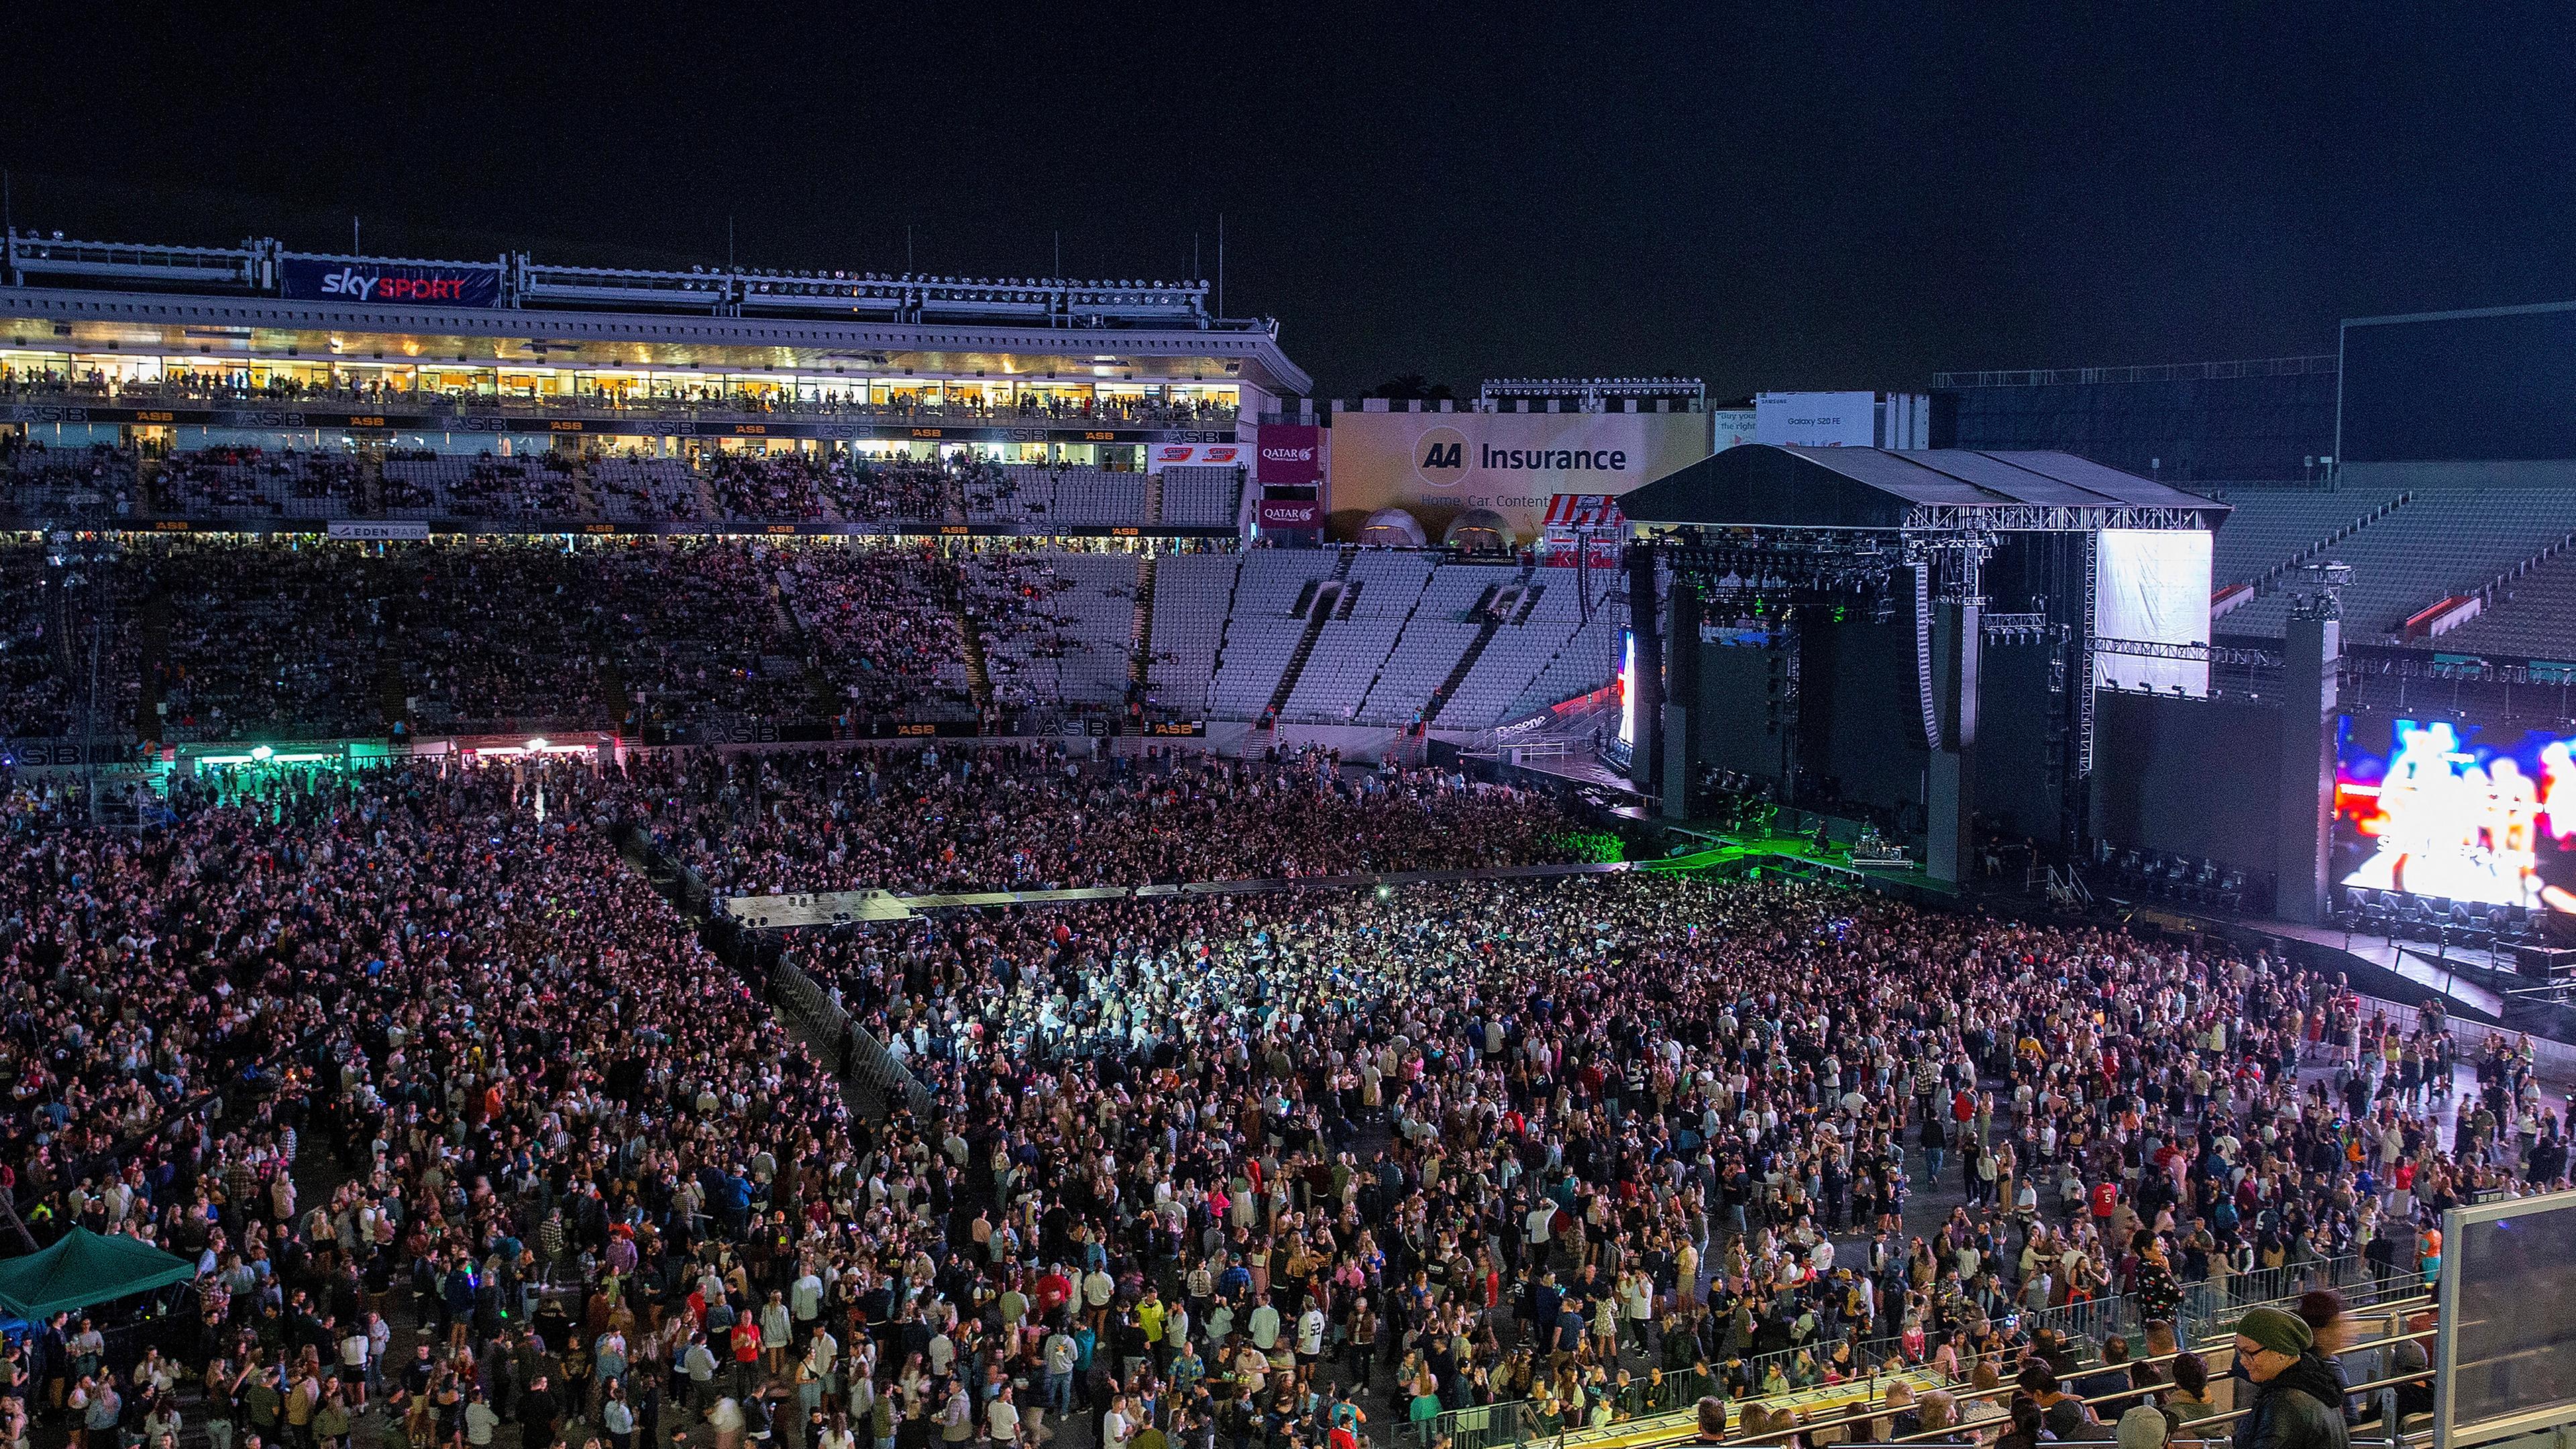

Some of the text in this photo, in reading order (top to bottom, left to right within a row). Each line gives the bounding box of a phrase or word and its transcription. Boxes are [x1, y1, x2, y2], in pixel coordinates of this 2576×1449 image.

[321, 268, 465, 301] sky SPORT
[136, 411, 174, 421] ASB
[350, 416, 384, 427] ASB
[551, 421, 582, 431] ASB
[1788, 417, 1815, 427] Galaxy
[735, 425, 766, 434] ASB
[912, 429, 941, 437] ASB
[1086, 431, 1114, 440] ASB
[1263, 449, 1298, 459] QATAR
[1422, 443, 1627, 470] AA Insurance
[1468, 495, 1492, 506] Car.
[1497, 495, 1550, 508] Content
[1265, 508, 1299, 519] QATAR
[156, 521, 187, 530] ASB
[586, 524, 614, 533] ASB
[767, 525, 794, 533] ASB
[941, 526, 967, 534] ASB
[355, 527, 389, 537] EDEN
[1112, 527, 1138, 535] ASB
[898, 724, 934, 735] ASB
[1036, 719, 1110, 737] ASB
[1155, 724, 1192, 734] ASB
[1227, 1105, 1236, 1115] 16
[2104, 1193, 2111, 1203] 5
